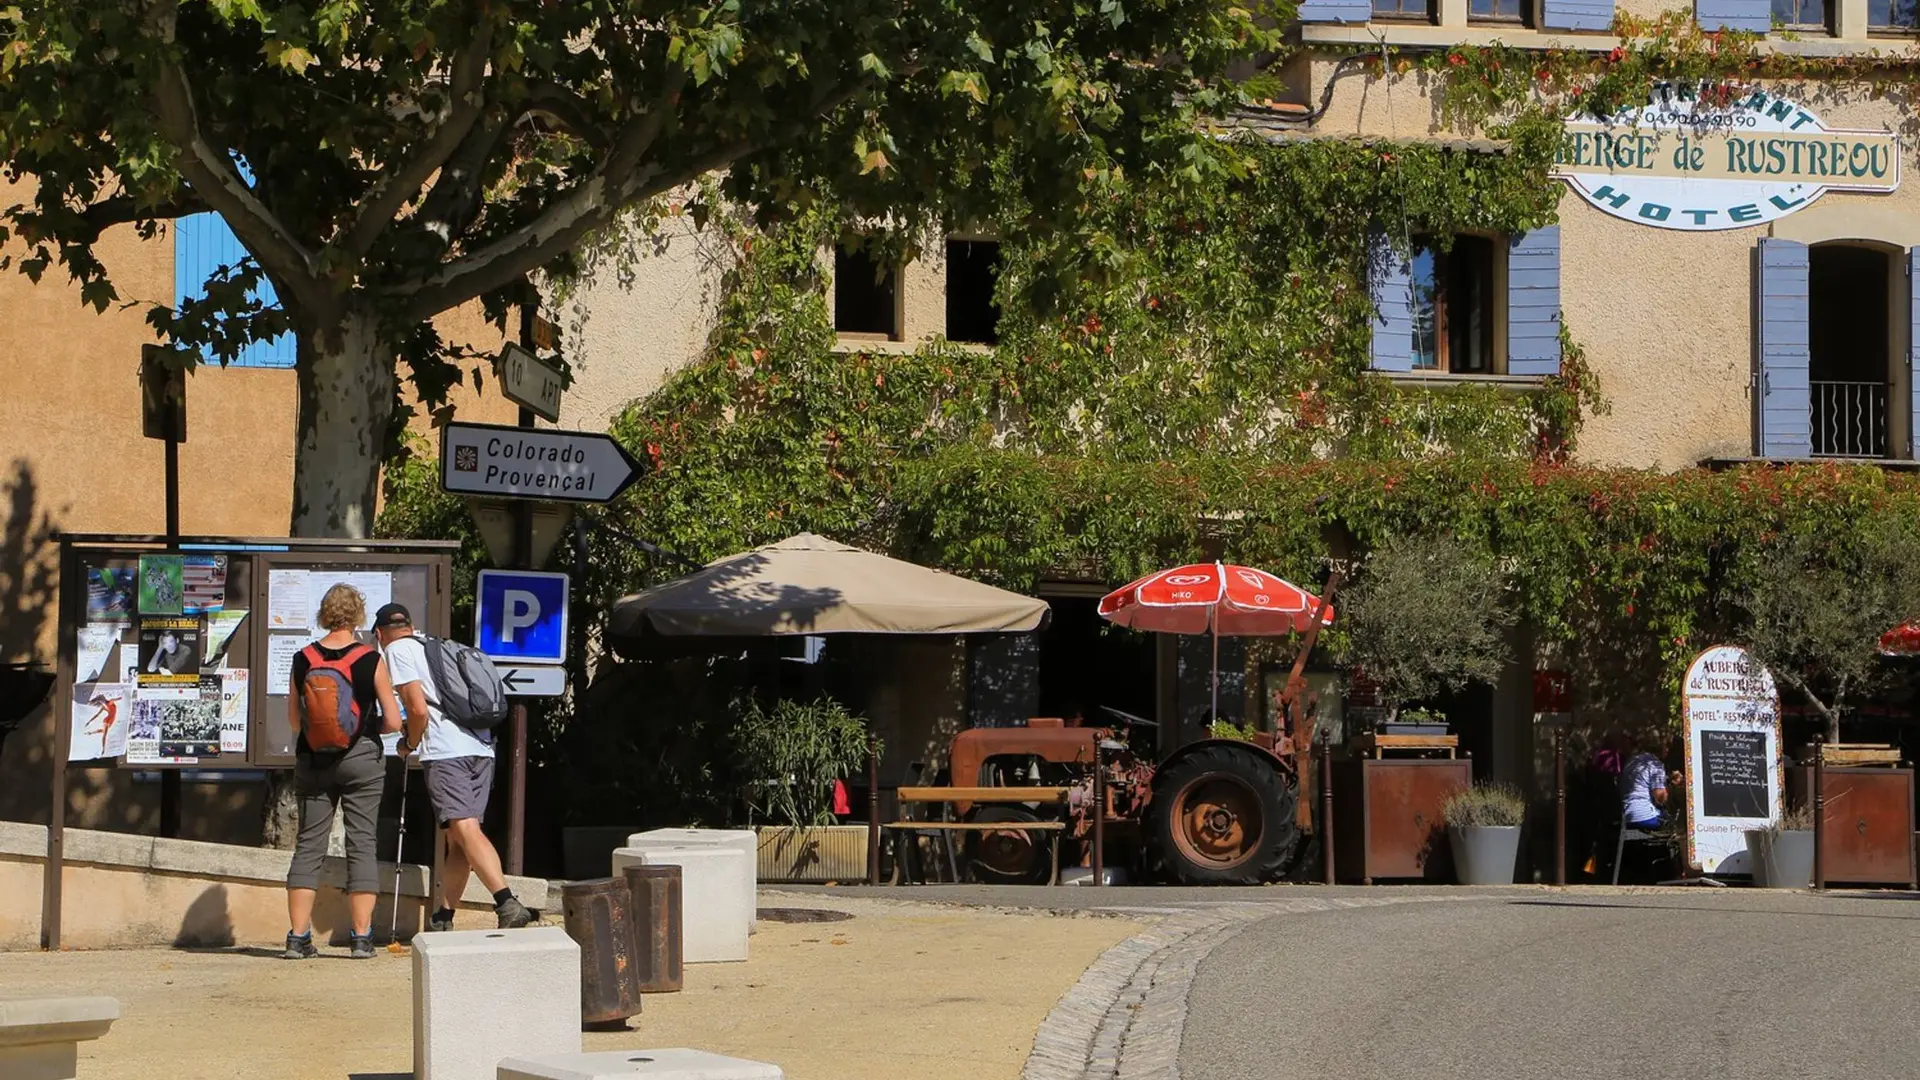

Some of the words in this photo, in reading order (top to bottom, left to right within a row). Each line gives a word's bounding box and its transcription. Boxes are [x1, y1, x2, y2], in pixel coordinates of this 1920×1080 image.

[1673, 137, 1705, 171] de
[1726, 137, 1889, 178] RUSTREOU
[1592, 185, 1806, 226] HOTEL
[486, 438, 586, 465] Colorado
[484, 465, 596, 493] Provençal
[501, 589, 541, 643] P
[1703, 660, 1753, 674] AUBERG
[1690, 678, 1703, 689] de
[1692, 710, 1716, 721] HOTEL
[1696, 823, 1728, 834] Cuisine
